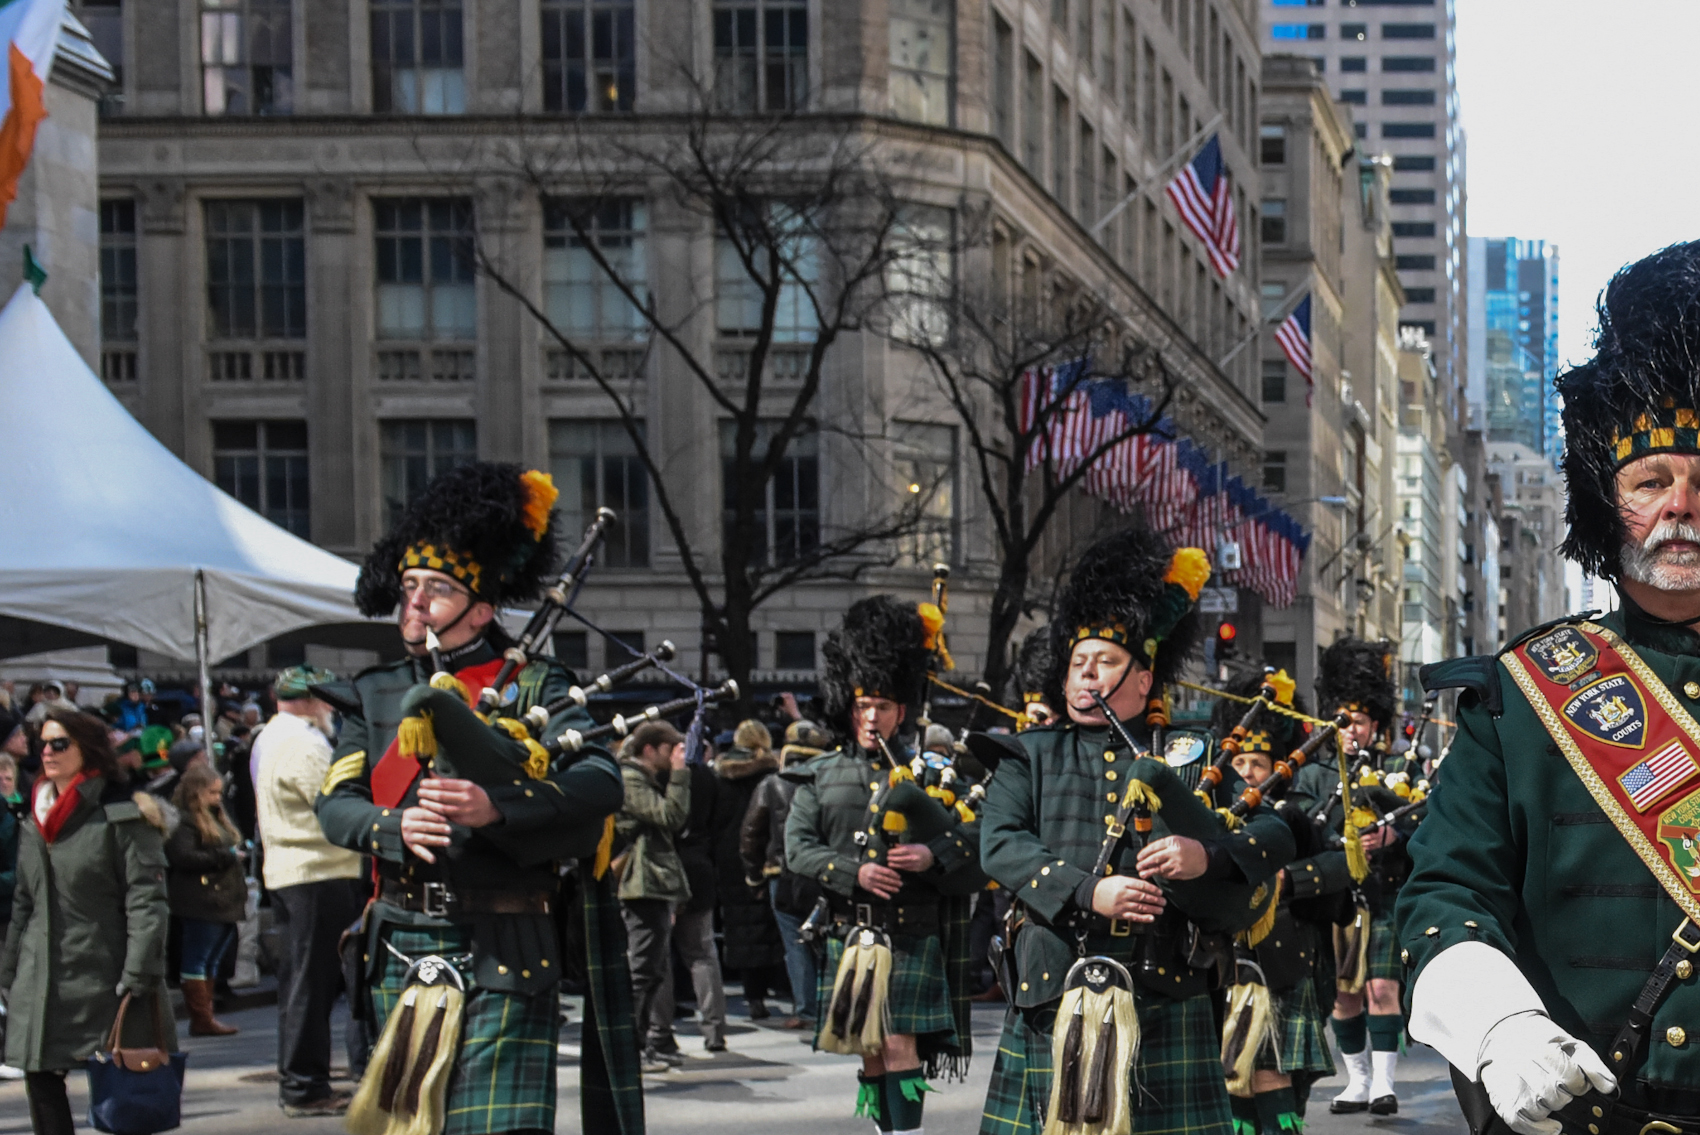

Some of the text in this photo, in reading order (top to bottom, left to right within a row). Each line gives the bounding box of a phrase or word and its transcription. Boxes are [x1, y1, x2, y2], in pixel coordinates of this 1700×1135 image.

[1565, 699, 1582, 717] NEW
[1578, 687, 1601, 702] YORK
[1598, 677, 1625, 692] STATE
[1612, 719, 1642, 742] COURTS
[1662, 811, 1677, 825] NEW
[1676, 802, 1691, 815] YORK
